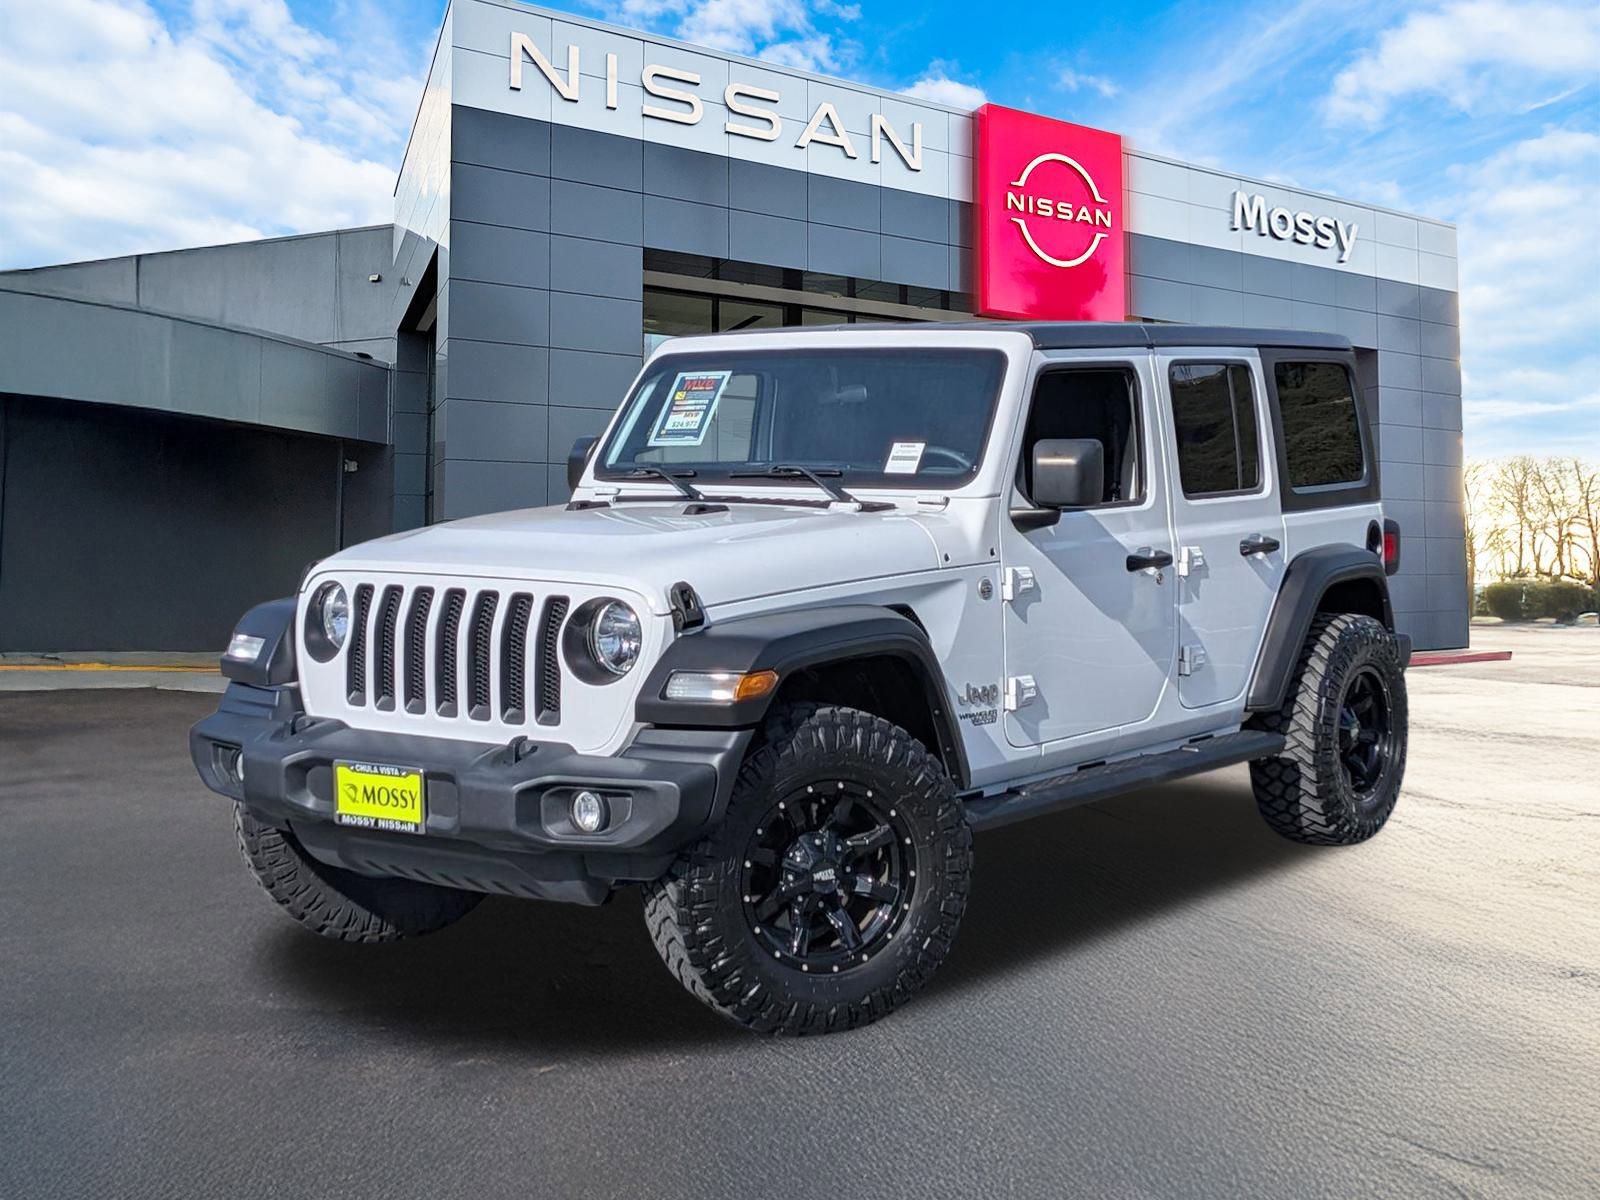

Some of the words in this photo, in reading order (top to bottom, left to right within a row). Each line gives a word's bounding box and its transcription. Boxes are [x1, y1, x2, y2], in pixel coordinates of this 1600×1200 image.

[509, 31, 922, 171] NISSAN
[1007, 191, 1112, 228] NISSAN
[1231, 190, 1359, 263] Mossy
[958, 682, 998, 708] Jeep
[355, 763, 379, 775] CHULA
[379, 766, 400, 776] VISTA
[362, 784, 418, 810] MOSSY
[341, 814, 376, 828] MOSSY
[377, 817, 416, 833] NISSAN
